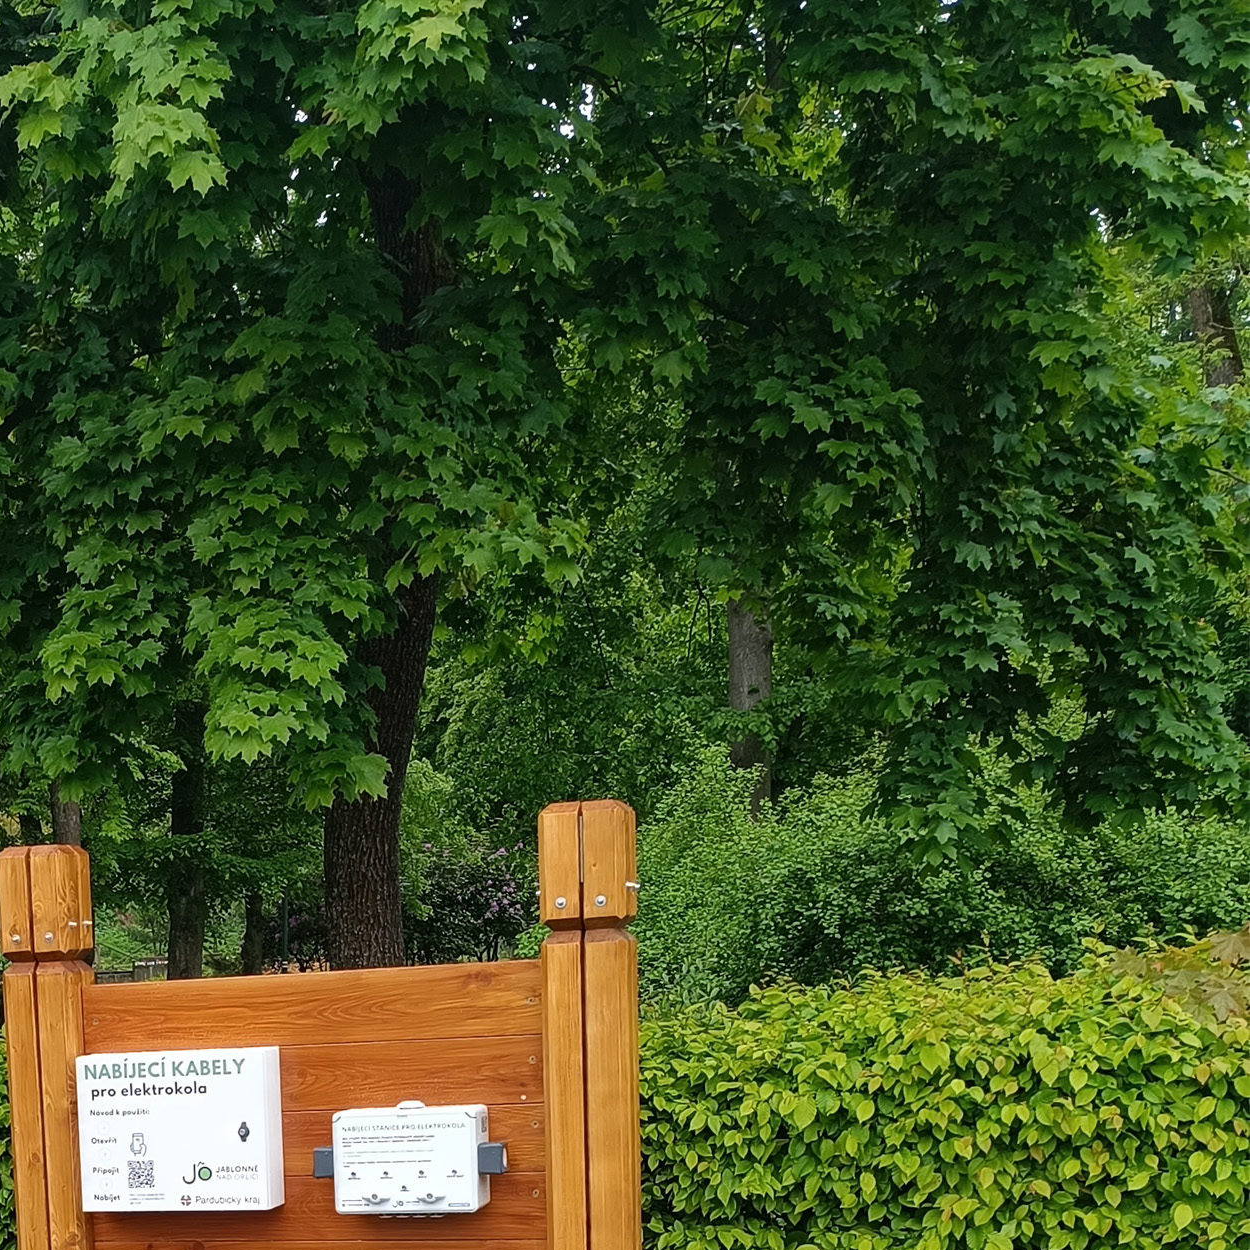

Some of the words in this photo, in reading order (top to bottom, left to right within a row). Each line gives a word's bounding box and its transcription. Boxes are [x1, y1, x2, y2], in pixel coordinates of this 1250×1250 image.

[84, 1057, 166, 1080] NABÍJECÍ
[172, 1058, 246, 1077] KABELY
[91, 1086, 117, 1101] pro
[121, 1081, 208, 1097] elektrokola
[372, 1123, 400, 1131] STANICE
[401, 1123, 416, 1131] PRO
[418, 1121, 466, 1130] ELEKTROKOLA
[215, 1164, 259, 1174] JABLONNÉ
[244, 1196, 260, 1206] kraj
